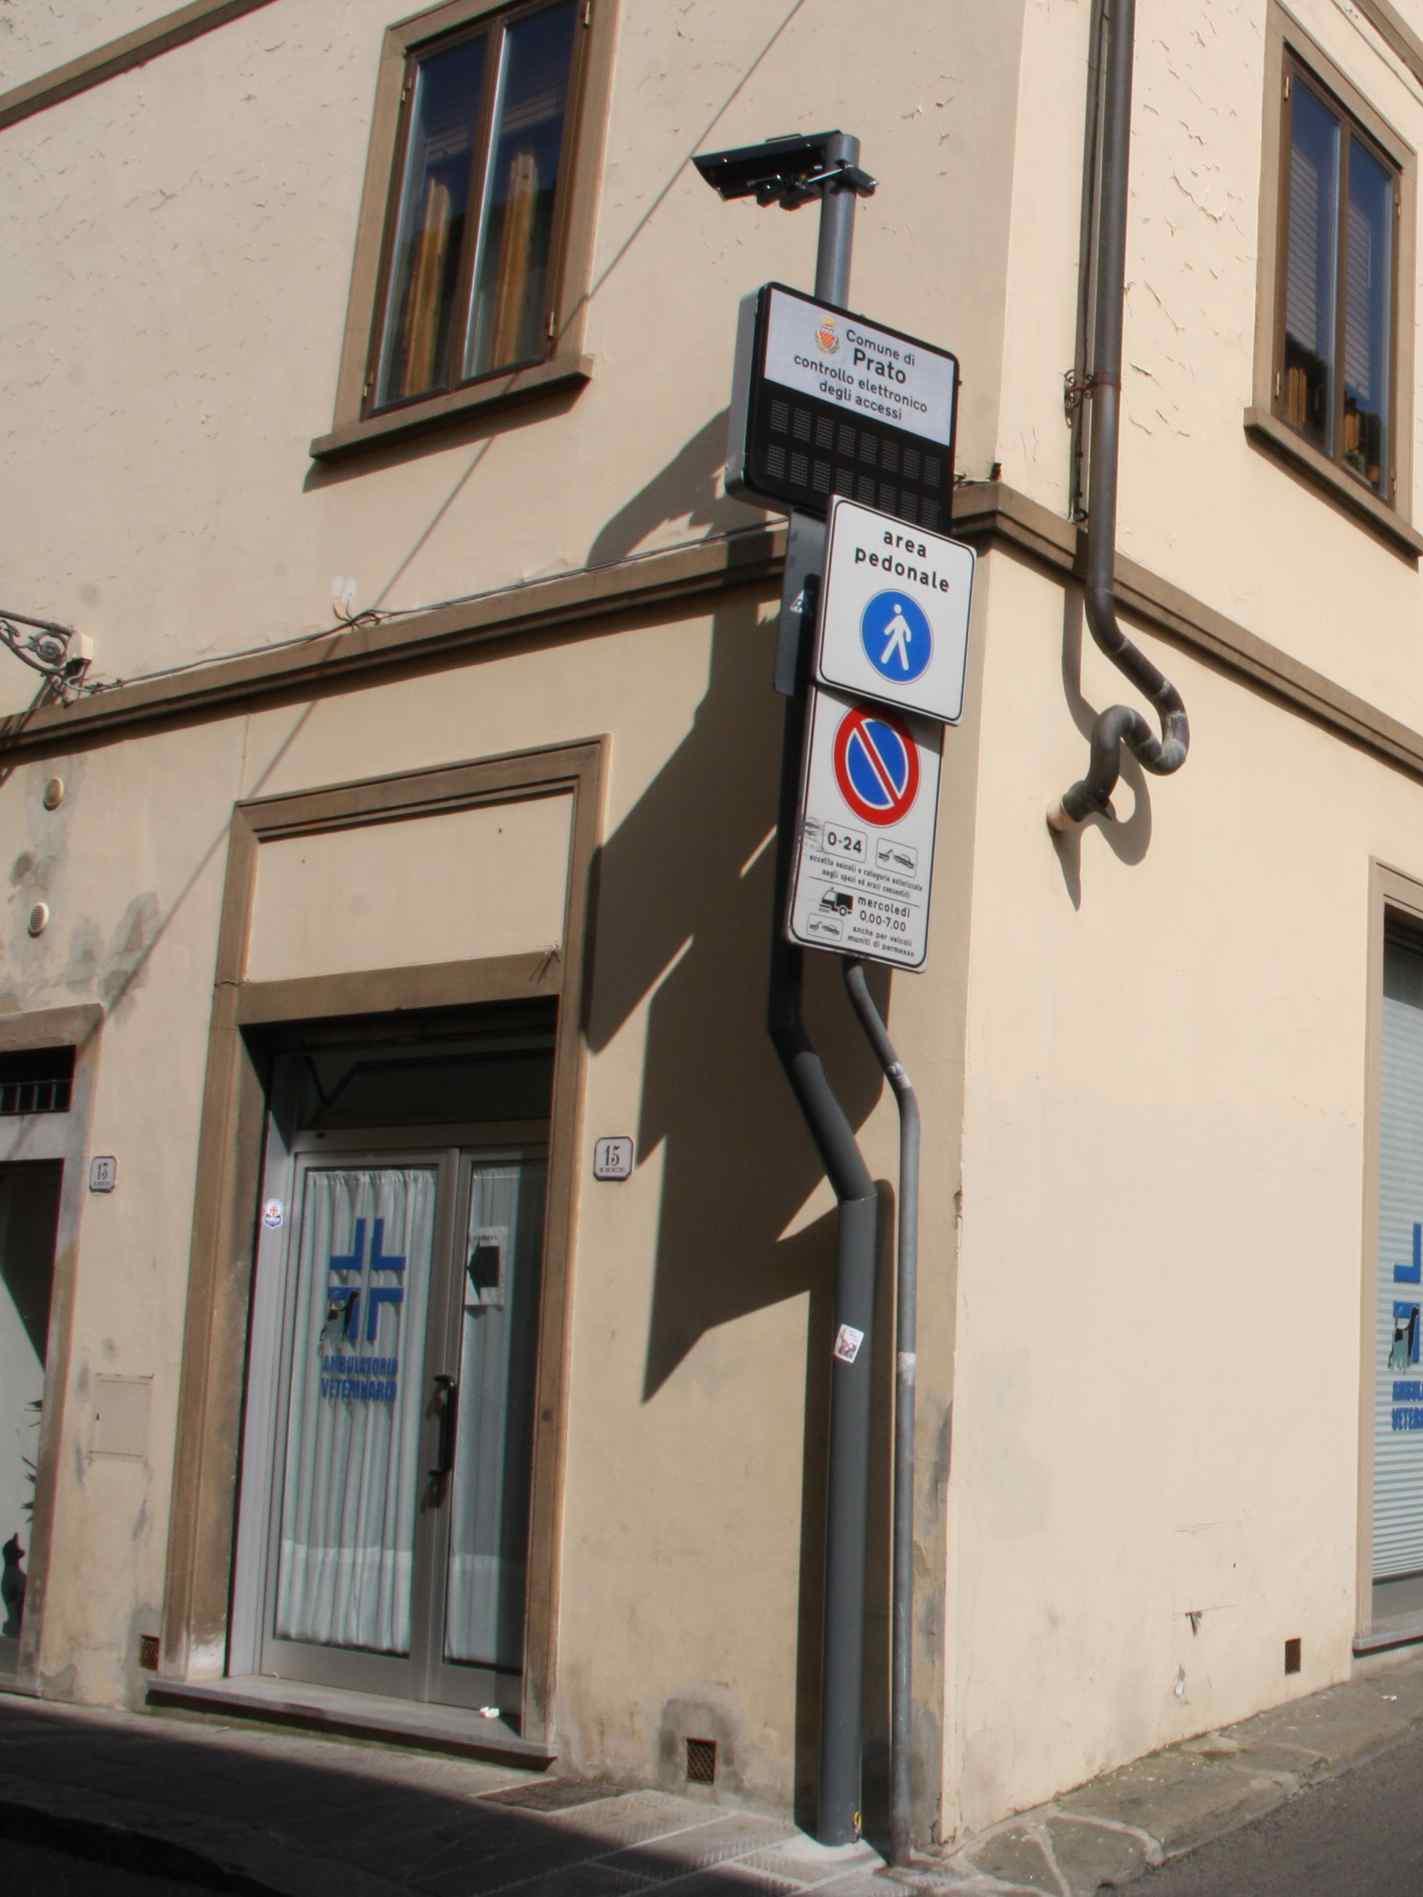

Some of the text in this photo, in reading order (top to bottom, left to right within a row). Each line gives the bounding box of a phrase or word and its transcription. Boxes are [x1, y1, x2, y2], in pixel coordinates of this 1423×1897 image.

[846, 329, 916, 366] Comune di
[853, 348, 907, 384] Prato
[794, 354, 928, 413] controllo elettronico
[819, 380, 902, 420] degli accessi
[883, 530, 927, 558] area
[855, 547, 949, 592] pedonale
[605, 1144, 620, 1166] 15
